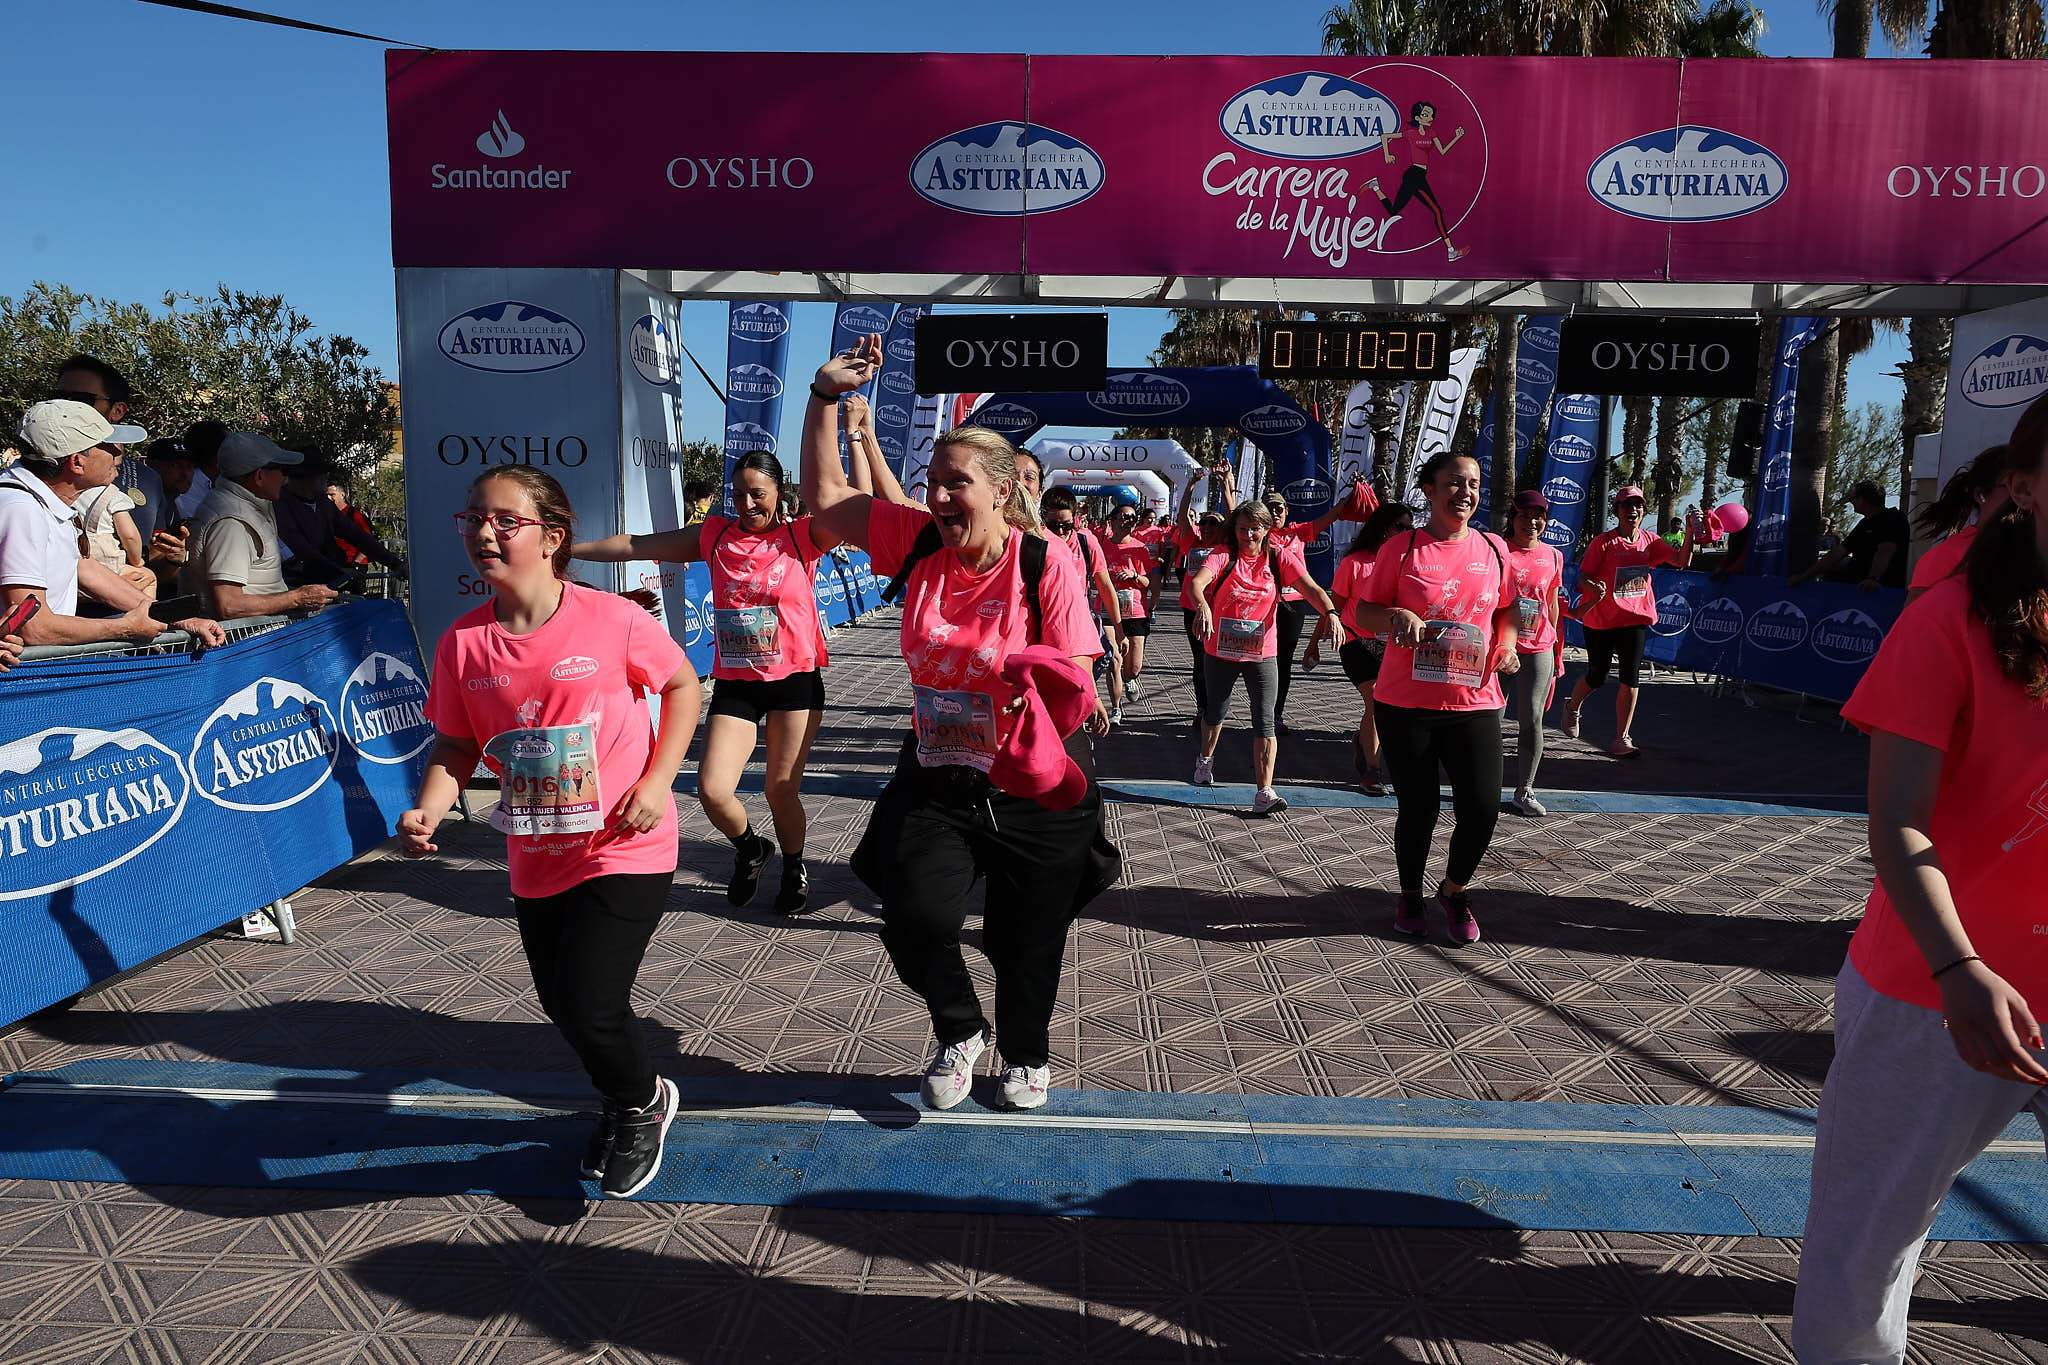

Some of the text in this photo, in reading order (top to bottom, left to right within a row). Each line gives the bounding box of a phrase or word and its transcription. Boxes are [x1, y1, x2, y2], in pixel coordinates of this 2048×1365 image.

[1233, 103, 1385, 138] ASTURIANA
[1261, 101, 1381, 112] CENTRAL LECHERA
[954, 154, 1015, 163] CENTRAL
[1633, 158, 1767, 169] CENTRAL LECHERA
[431, 163, 572, 189] Santander
[666, 156, 815, 190] OYSHO
[925, 156, 1090, 191] ASTURIANA
[1202, 152, 1350, 198] Carrera
[1601, 160, 1771, 197] ASTURIANA
[1887, 165, 2047, 198] OYSHO
[1236, 194, 1403, 268] de la Mujer
[471, 326, 570, 334] CENTRAL LECHERA
[842, 313, 886, 331] ASTURIANA
[449, 327, 575, 355] ASTURIANA
[945, 339, 1080, 368] OYSHO
[1272, 331, 1436, 379] 01:10:20
[1590, 341, 1730, 373] OYSHO
[1516, 365, 1551, 382] STURIANA
[1094, 391, 1183, 406] ASTURIANA
[977, 413, 1034, 427] ASTURIANA
[1245, 415, 1304, 430] ASTURIANA
[437, 433, 589, 468] OYSHO
[632, 436, 678, 471] OYSHO
[1068, 444, 1149, 463] OYSHO
[639, 569, 676, 592] Santander
[1694, 613, 1738, 634] ASTURIANA
[1749, 618, 1803, 642] ASTURIANA
[1816, 625, 1876, 655] ASTURIANA
[467, 673, 511, 691] OYSHO
[232, 720, 279, 744] CENTRAL
[351, 699, 434, 744] ASTURIAN
[75, 753, 161, 786] LECHERA
[212, 724, 334, 793] ASTURIANA
[0, 773, 176, 857] TURIANA
[512, 807, 522, 815] DE
[559, 803, 594, 814] VALENCIA
